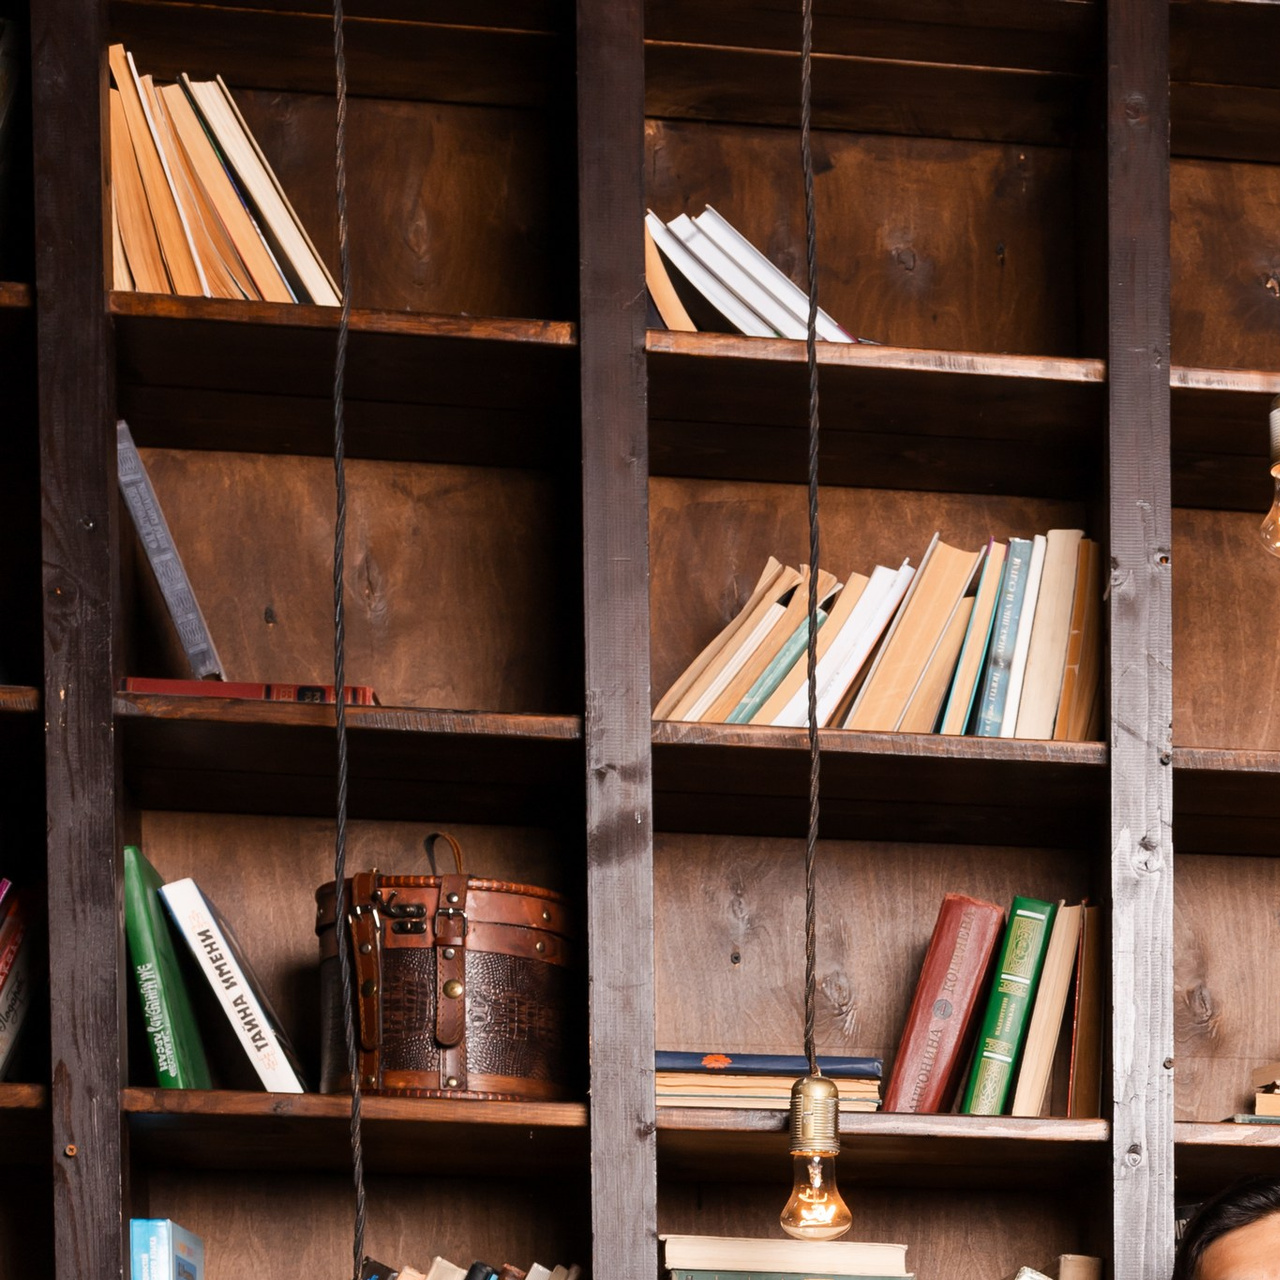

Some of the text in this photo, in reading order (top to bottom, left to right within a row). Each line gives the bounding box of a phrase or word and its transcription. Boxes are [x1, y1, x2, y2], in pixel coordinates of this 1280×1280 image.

[195, 924, 269, 1053] ТАЙНА ИМЕНИ
[906, 907, 977, 1112] АНТОНИНА КОПТЯЕВА
